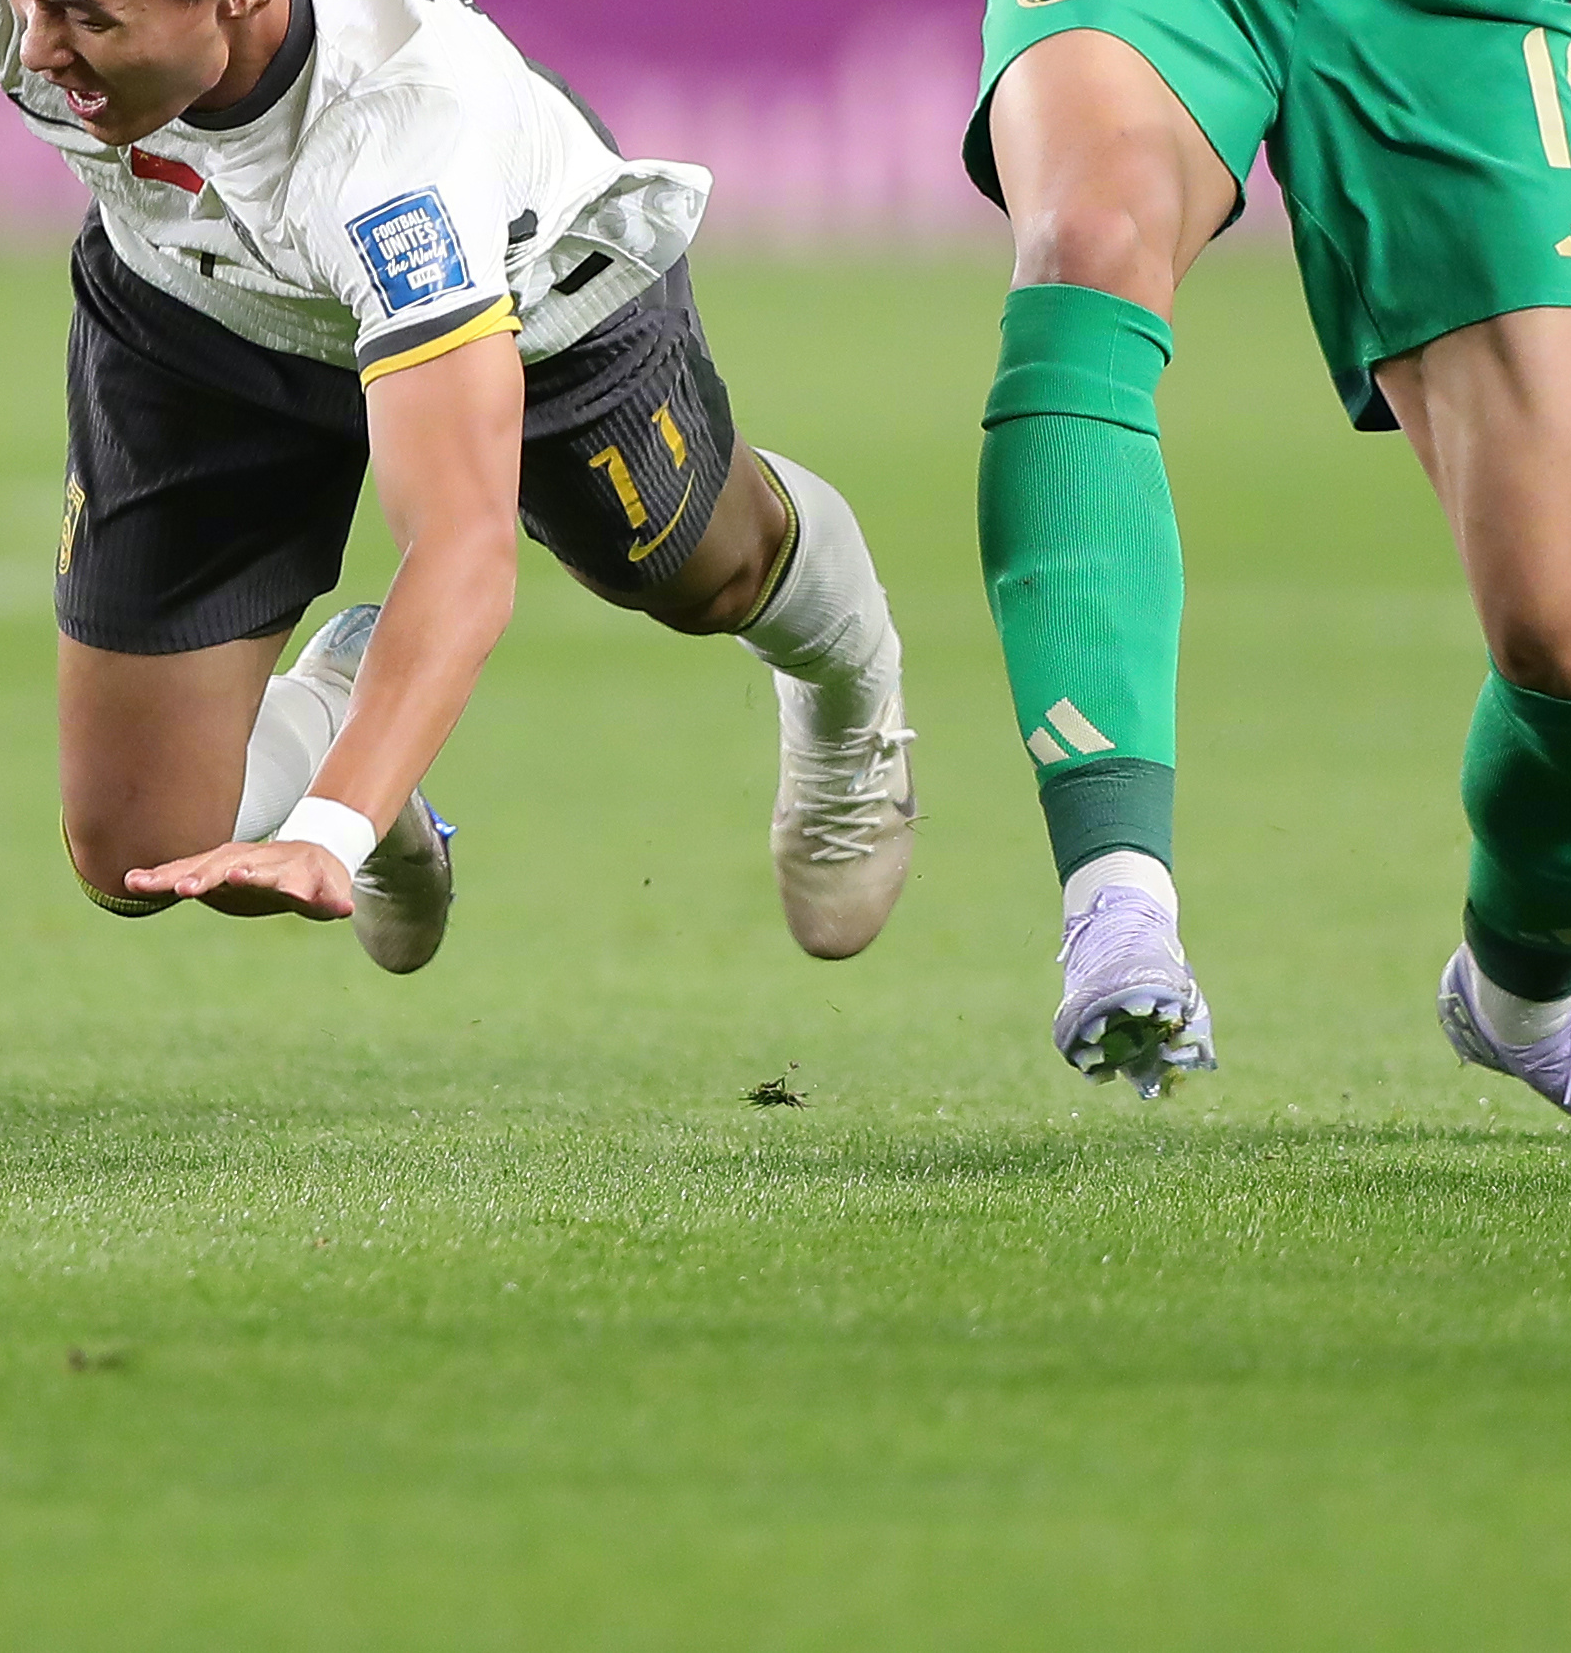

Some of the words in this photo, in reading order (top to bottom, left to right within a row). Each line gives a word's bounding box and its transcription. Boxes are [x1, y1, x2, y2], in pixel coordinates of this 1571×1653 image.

[371, 207, 430, 243] FOOTBALL
[378, 221, 438, 260] UNITES
[385, 258, 409, 279] the
[407, 238, 449, 269] World
[412, 269, 437, 285] FIFA
[588, 400, 688, 530] 11
